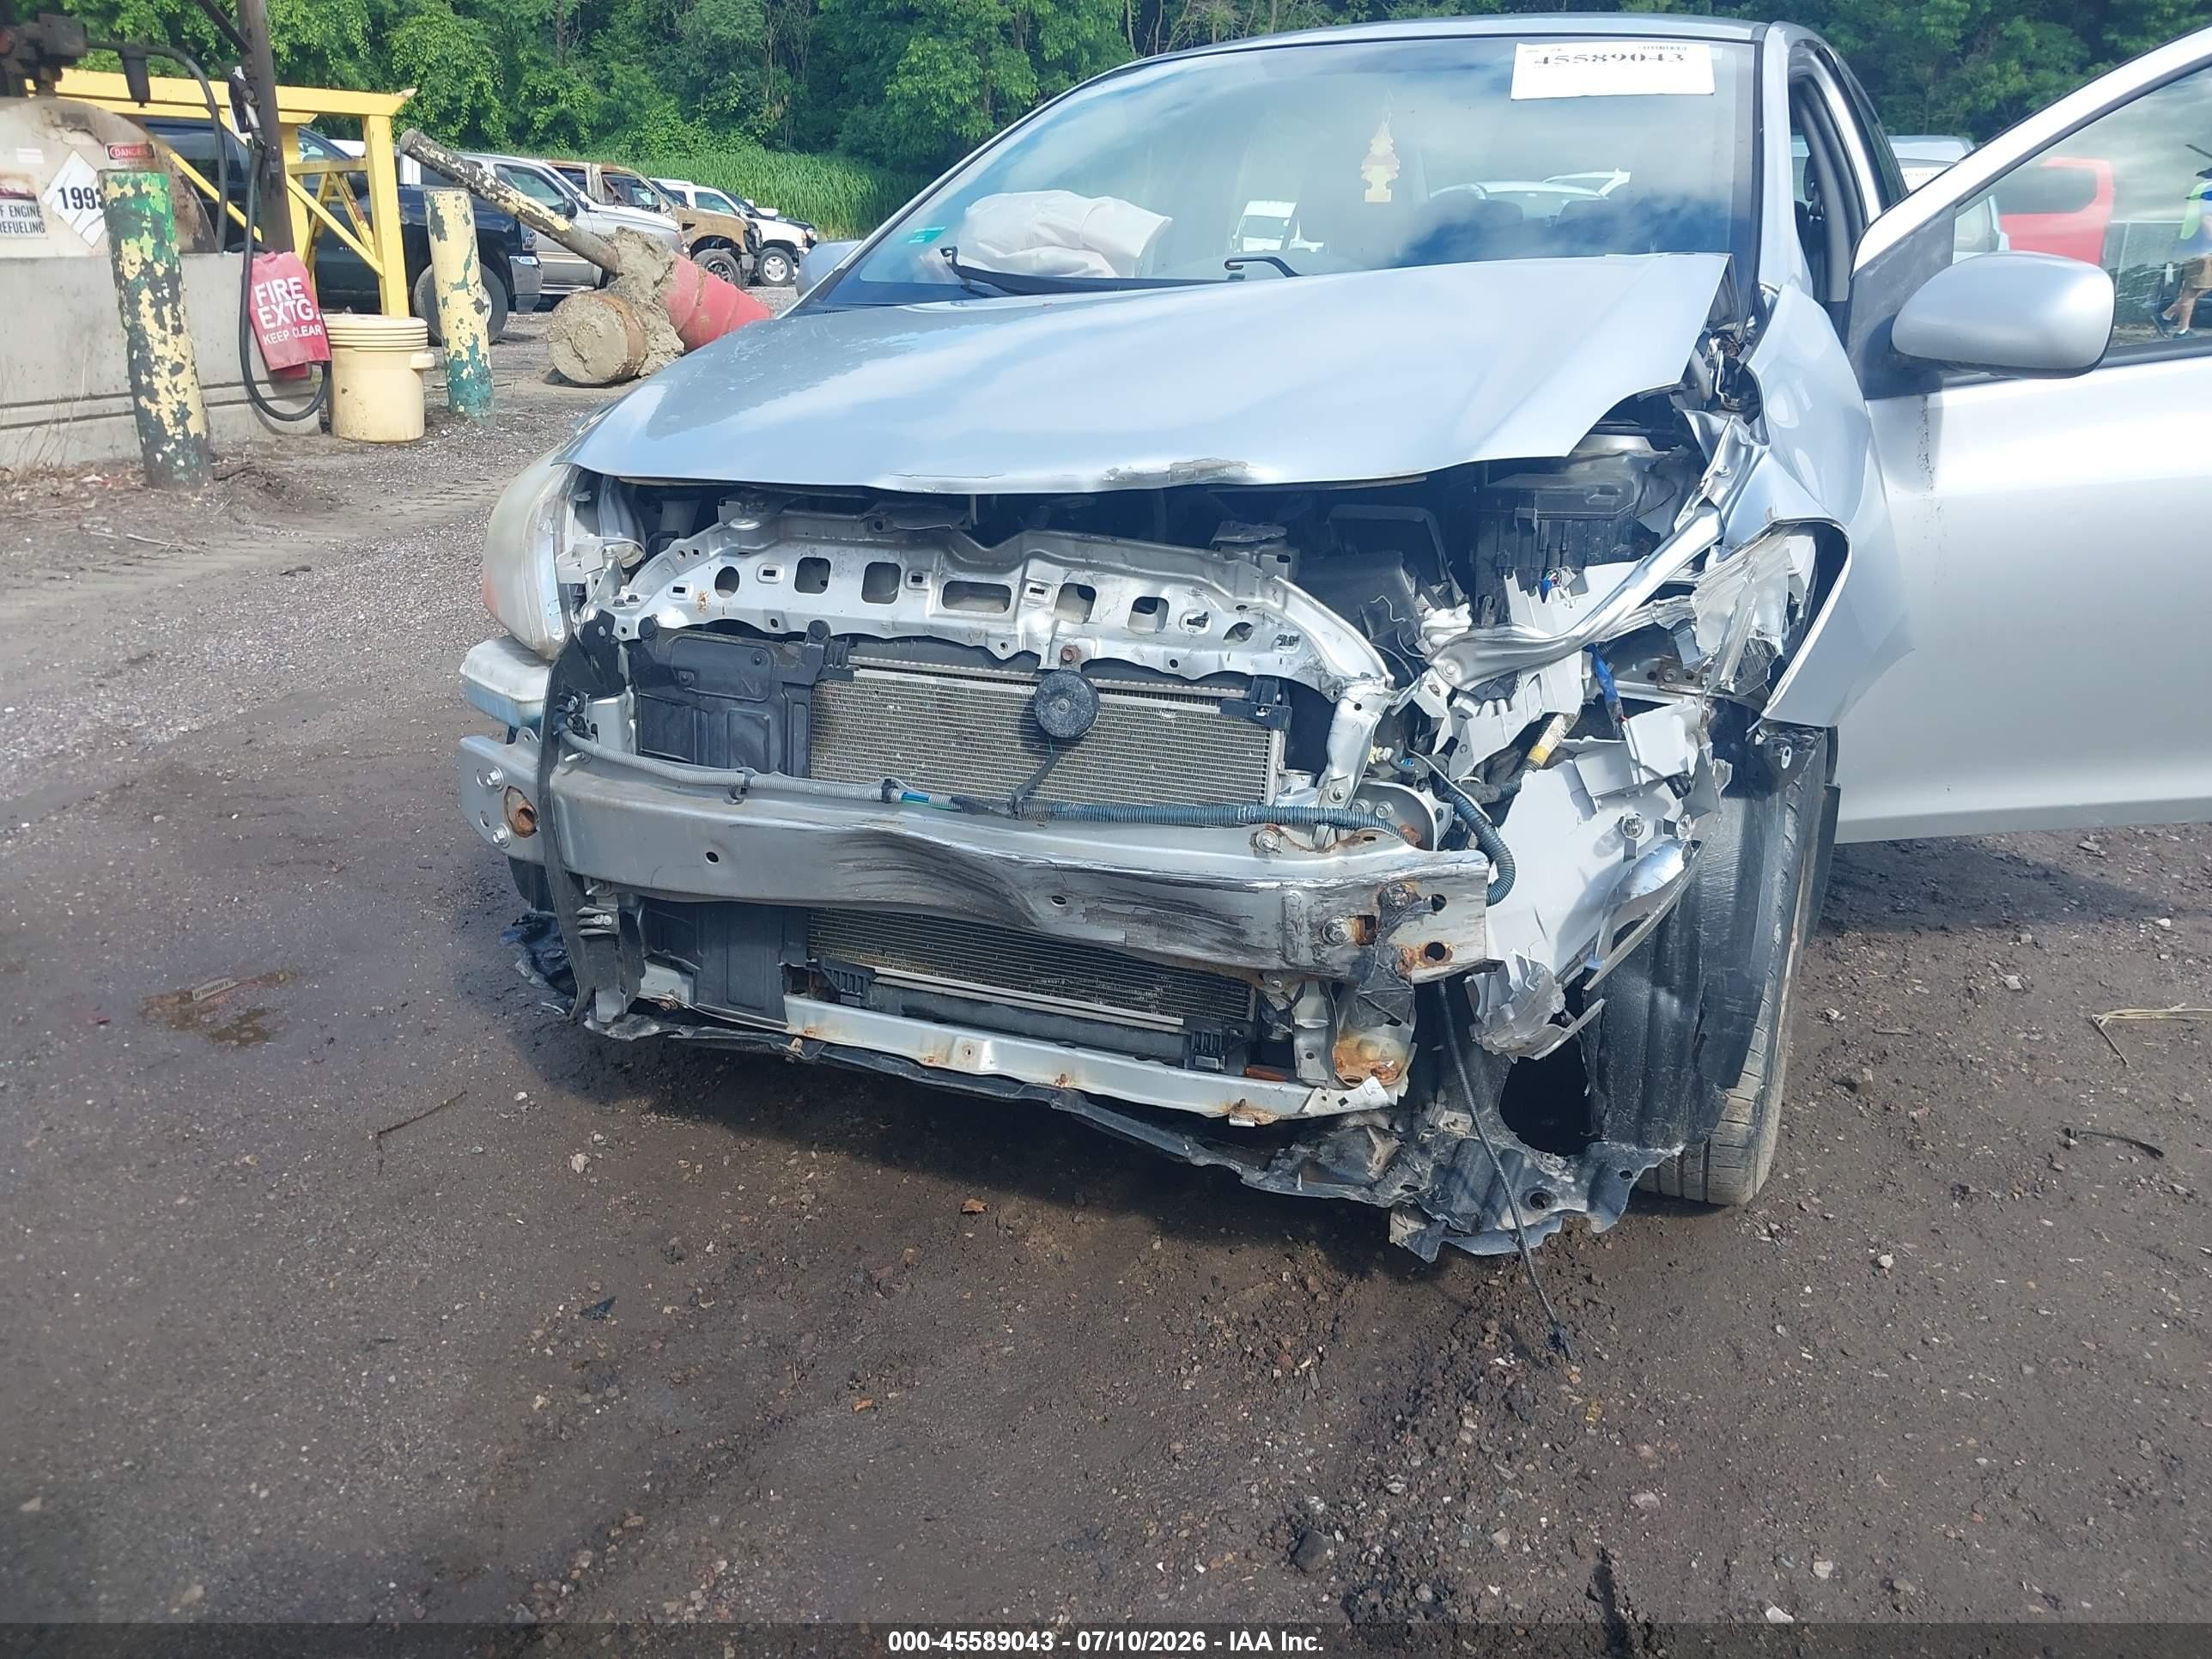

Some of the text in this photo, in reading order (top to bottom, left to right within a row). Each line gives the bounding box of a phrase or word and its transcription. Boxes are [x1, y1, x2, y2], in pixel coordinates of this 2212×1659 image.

[114, 148, 149, 157] DANGE
[9, 205, 42, 218] ENGINE
[253, 276, 306, 307] FIRE
[258, 298, 321, 330] EXTG.
[262, 325, 323, 345] KEEP CLEAR
